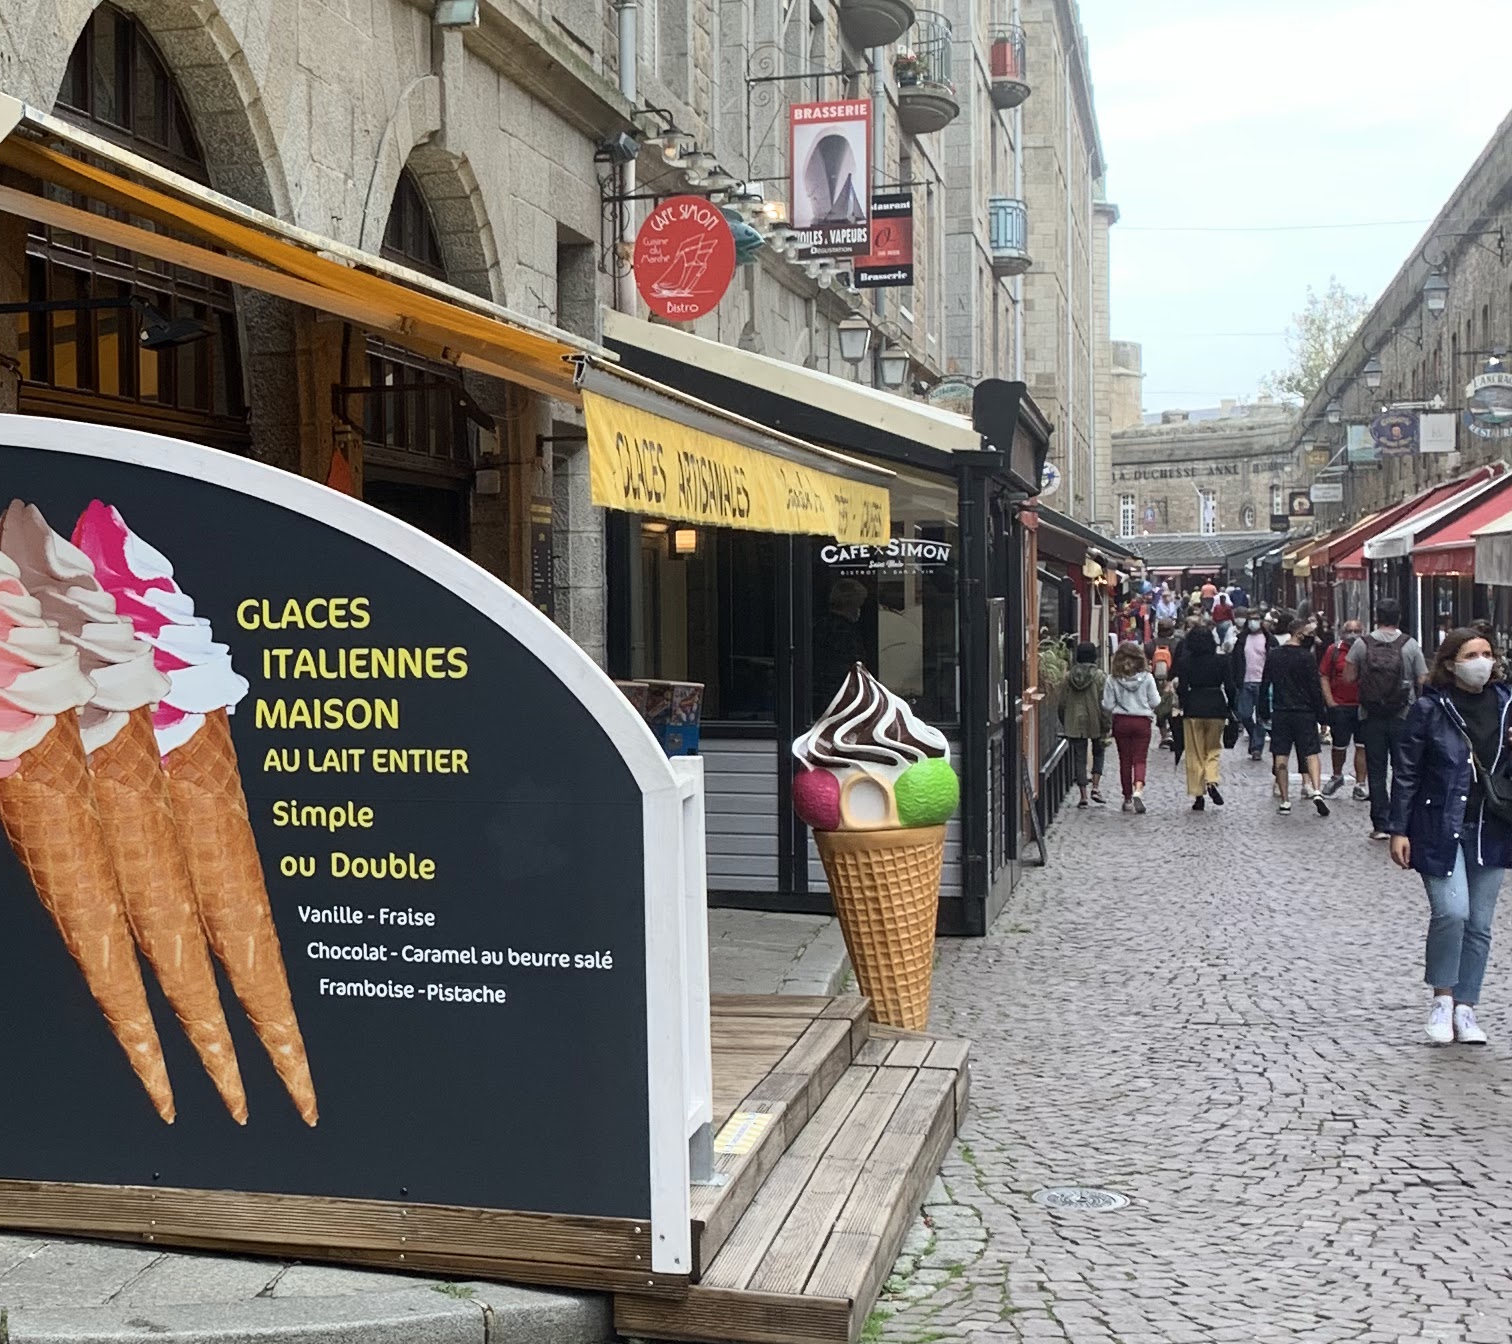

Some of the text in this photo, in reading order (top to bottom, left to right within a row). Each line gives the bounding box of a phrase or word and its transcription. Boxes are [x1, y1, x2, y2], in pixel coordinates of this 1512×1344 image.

[794, 104, 868, 120] BRASSERIE
[679, 204, 719, 231] SIMON
[830, 228, 867, 244] VAPEURS
[861, 271, 907, 281] Brasserie
[667, 301, 699, 313] Bistro
[616, 432, 666, 503] GLACES
[677, 450, 751, 518] ARTISANALES
[1134, 467, 1197, 481] DUCHESSE
[1208, 464, 1240, 476] ANNE
[821, 538, 951, 563] CAFE SIMON
[237, 598, 370, 629] GLACES
[264, 647, 468, 679] ITALIENNES
[256, 698, 398, 729] MAISON
[264, 749, 468, 773] AU LAIT ENTIER
[273, 800, 373, 832] Simple
[281, 853, 435, 879] ou Double
[298, 906, 363, 924] Vanille
[380, 908, 435, 926] Fraise
[307, 942, 387, 961] Chocolat
[402, 945, 478, 964] Caramel
[481, 951, 503, 965] au
[508, 948, 570, 967] beurre
[575, 951, 612, 969] salé
[320, 979, 414, 998] Framboise
